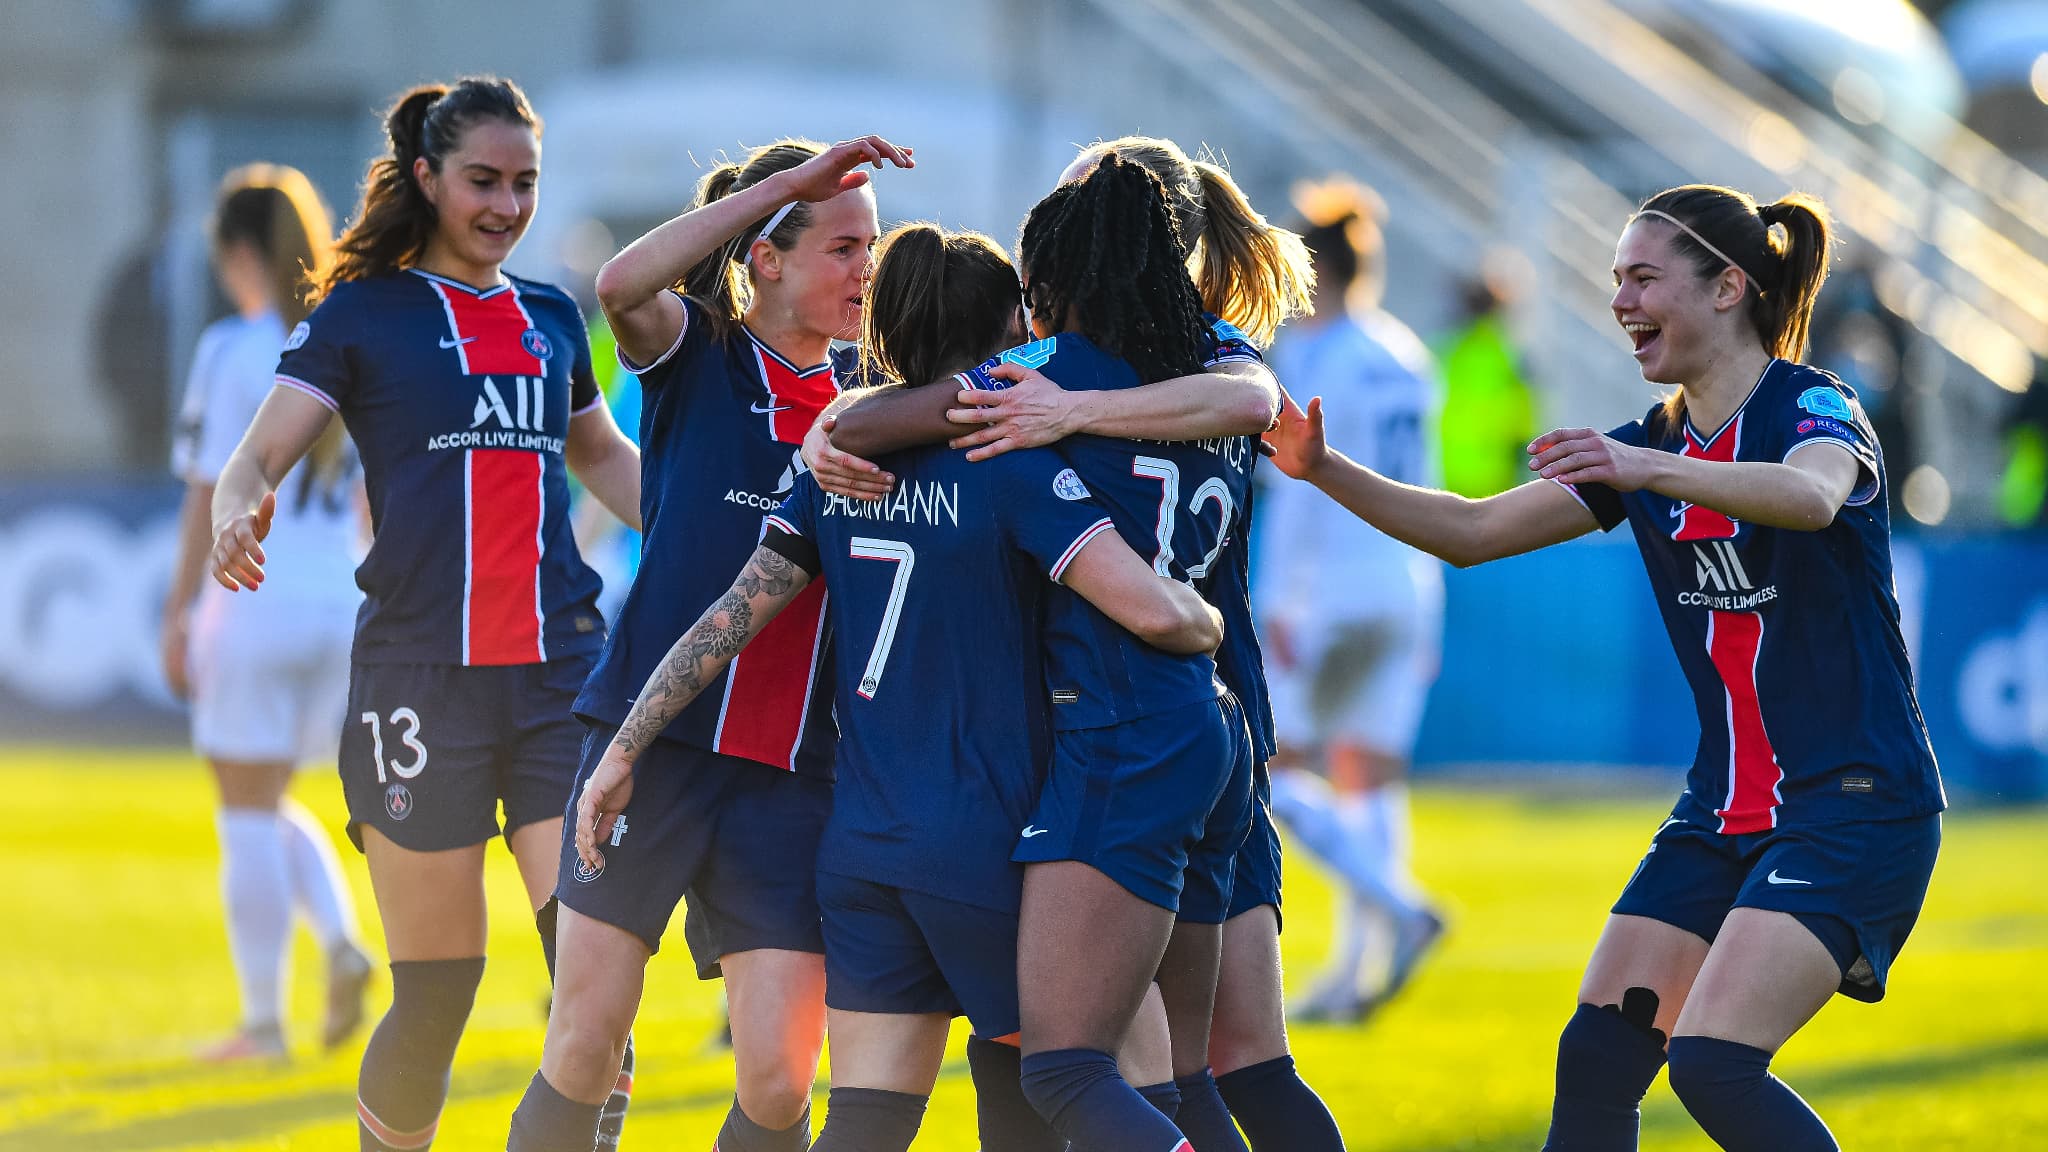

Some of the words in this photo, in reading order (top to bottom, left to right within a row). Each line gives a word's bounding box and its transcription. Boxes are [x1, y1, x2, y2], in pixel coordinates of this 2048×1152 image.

[427, 432, 482, 452] ACCOR
[484, 430, 516, 447] LIVE
[1816, 420, 1855, 442] RESPE
[849, 536, 915, 702] 7
[361, 706, 428, 784] 13
